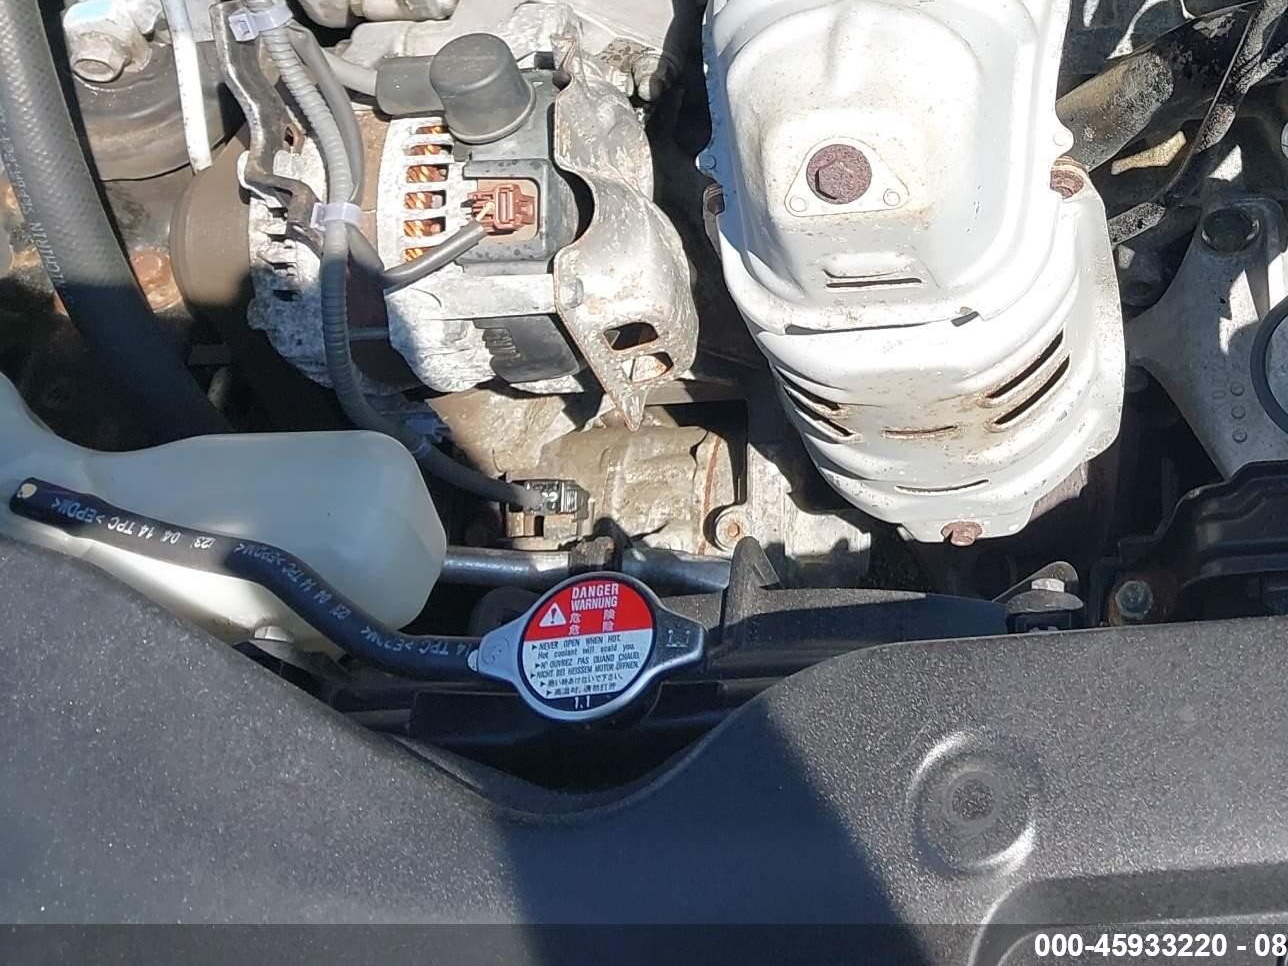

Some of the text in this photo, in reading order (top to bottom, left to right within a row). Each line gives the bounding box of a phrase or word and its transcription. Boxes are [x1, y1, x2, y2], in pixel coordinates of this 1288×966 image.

[107, 516, 135, 535] TPC
[137, 524, 155, 539] 14
[161, 531, 182, 544] 04
[572, 583, 619, 599] DANGER
[571, 596, 618, 611] WARNUNG
[539, 641, 559, 651] NEVER
[563, 639, 580, 647] OPEN
[585, 636, 603, 645] WHEN
[538, 651, 549, 659] Hot
[554, 648, 577, 657] coolant
[582, 646, 595, 654] will
[600, 644, 617, 653] scald
[577, 656, 589, 665] PAS
[593, 654, 615, 664] QUAND
[536, 670, 553, 679] NICHT
[556, 668, 566, 676] BEI
[568, 665, 592, 675] HEISSEM
[595, 663, 614, 672] MOTOR
[575, 695, 590, 709] 1.1
